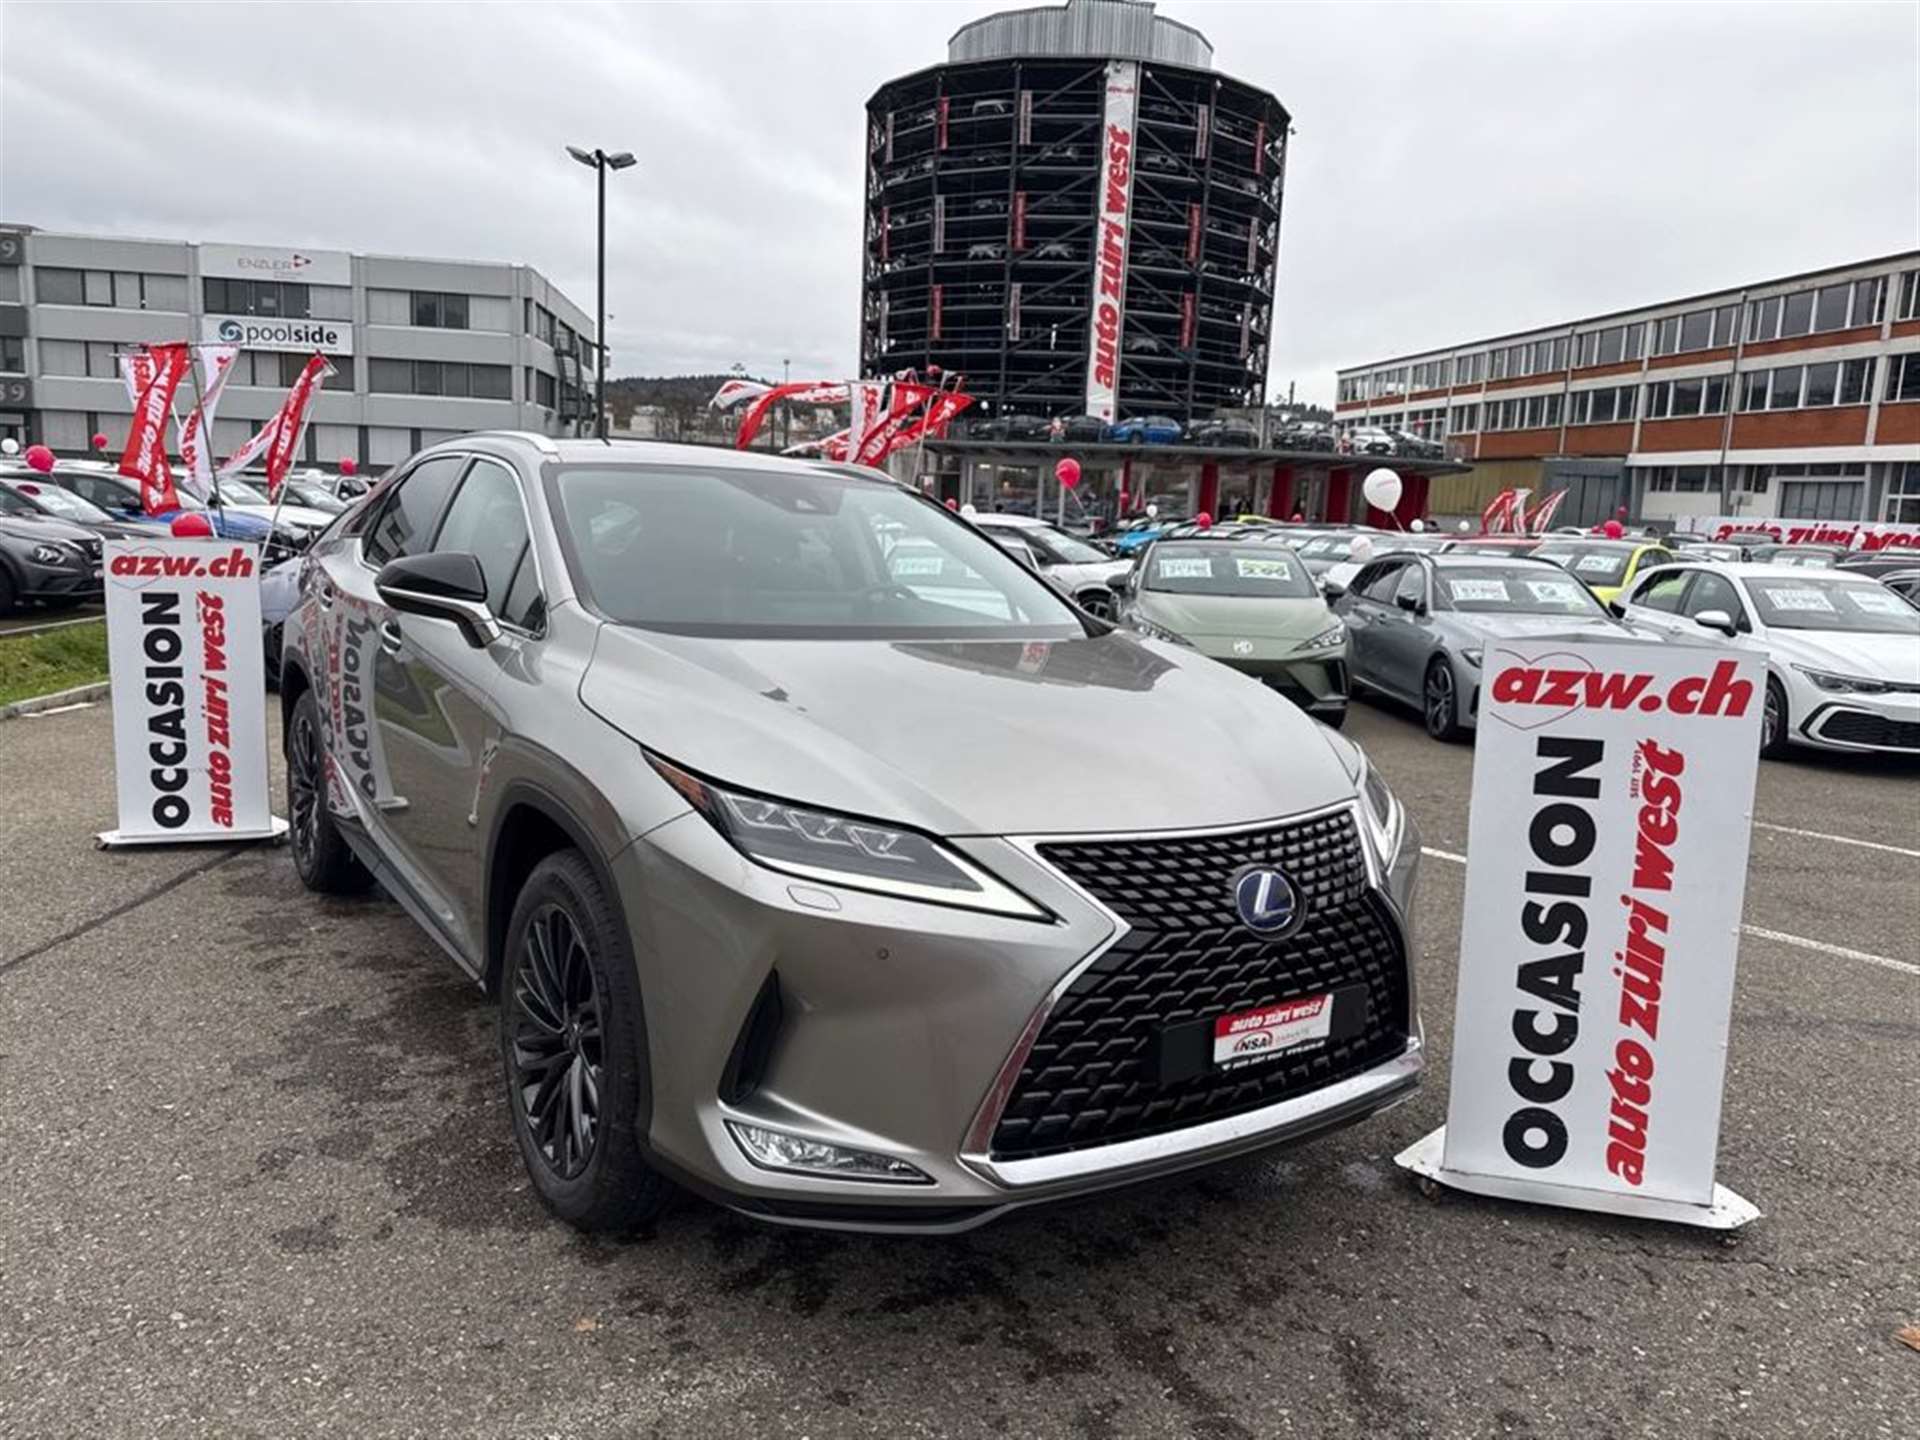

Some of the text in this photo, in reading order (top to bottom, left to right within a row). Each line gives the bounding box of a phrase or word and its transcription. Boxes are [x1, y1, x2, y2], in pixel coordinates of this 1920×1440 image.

[1095, 123, 1131, 390] auto züri west
[247, 323, 338, 345] poolside
[110, 548, 253, 578] azw.ch
[141, 592, 191, 829] OCCASION
[197, 590, 233, 828] auto züri west
[1492, 660, 1754, 718] azw.ch
[1630, 777, 1640, 799] SEIT
[1502, 735, 1605, 1169] OCCASION
[1606, 737, 1686, 1186] auto züri west
[1229, 1000, 1323, 1034] auto züri west
[1240, 1037, 1269, 1052] NSA
